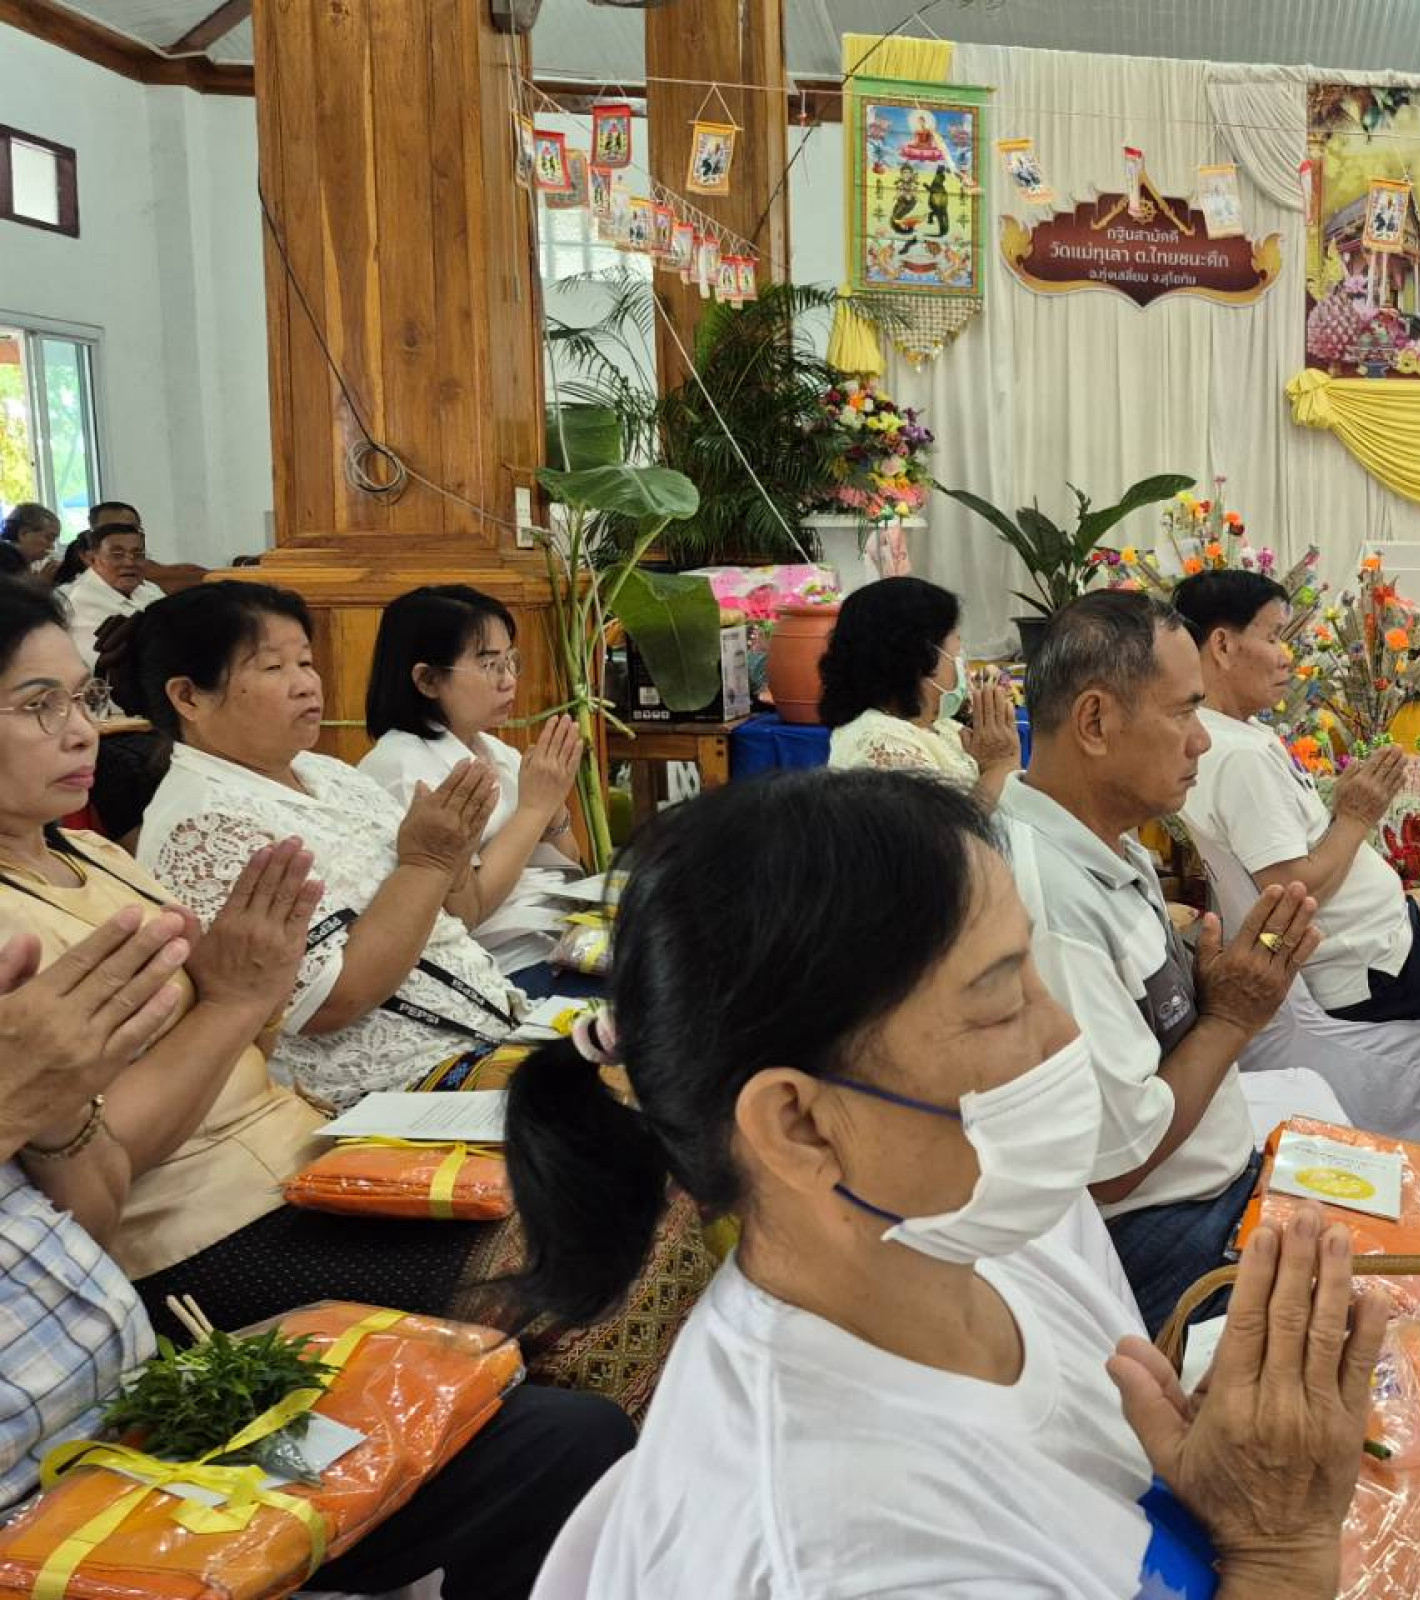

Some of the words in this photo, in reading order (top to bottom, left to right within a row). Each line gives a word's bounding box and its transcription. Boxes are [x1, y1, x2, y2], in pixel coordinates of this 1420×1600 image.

[1107, 227, 1179, 244] กฐินสามัคคี
[1050, 241, 1129, 263] วัดแม่ทุเลา
[400, 1001, 440, 1025] PEPSI
